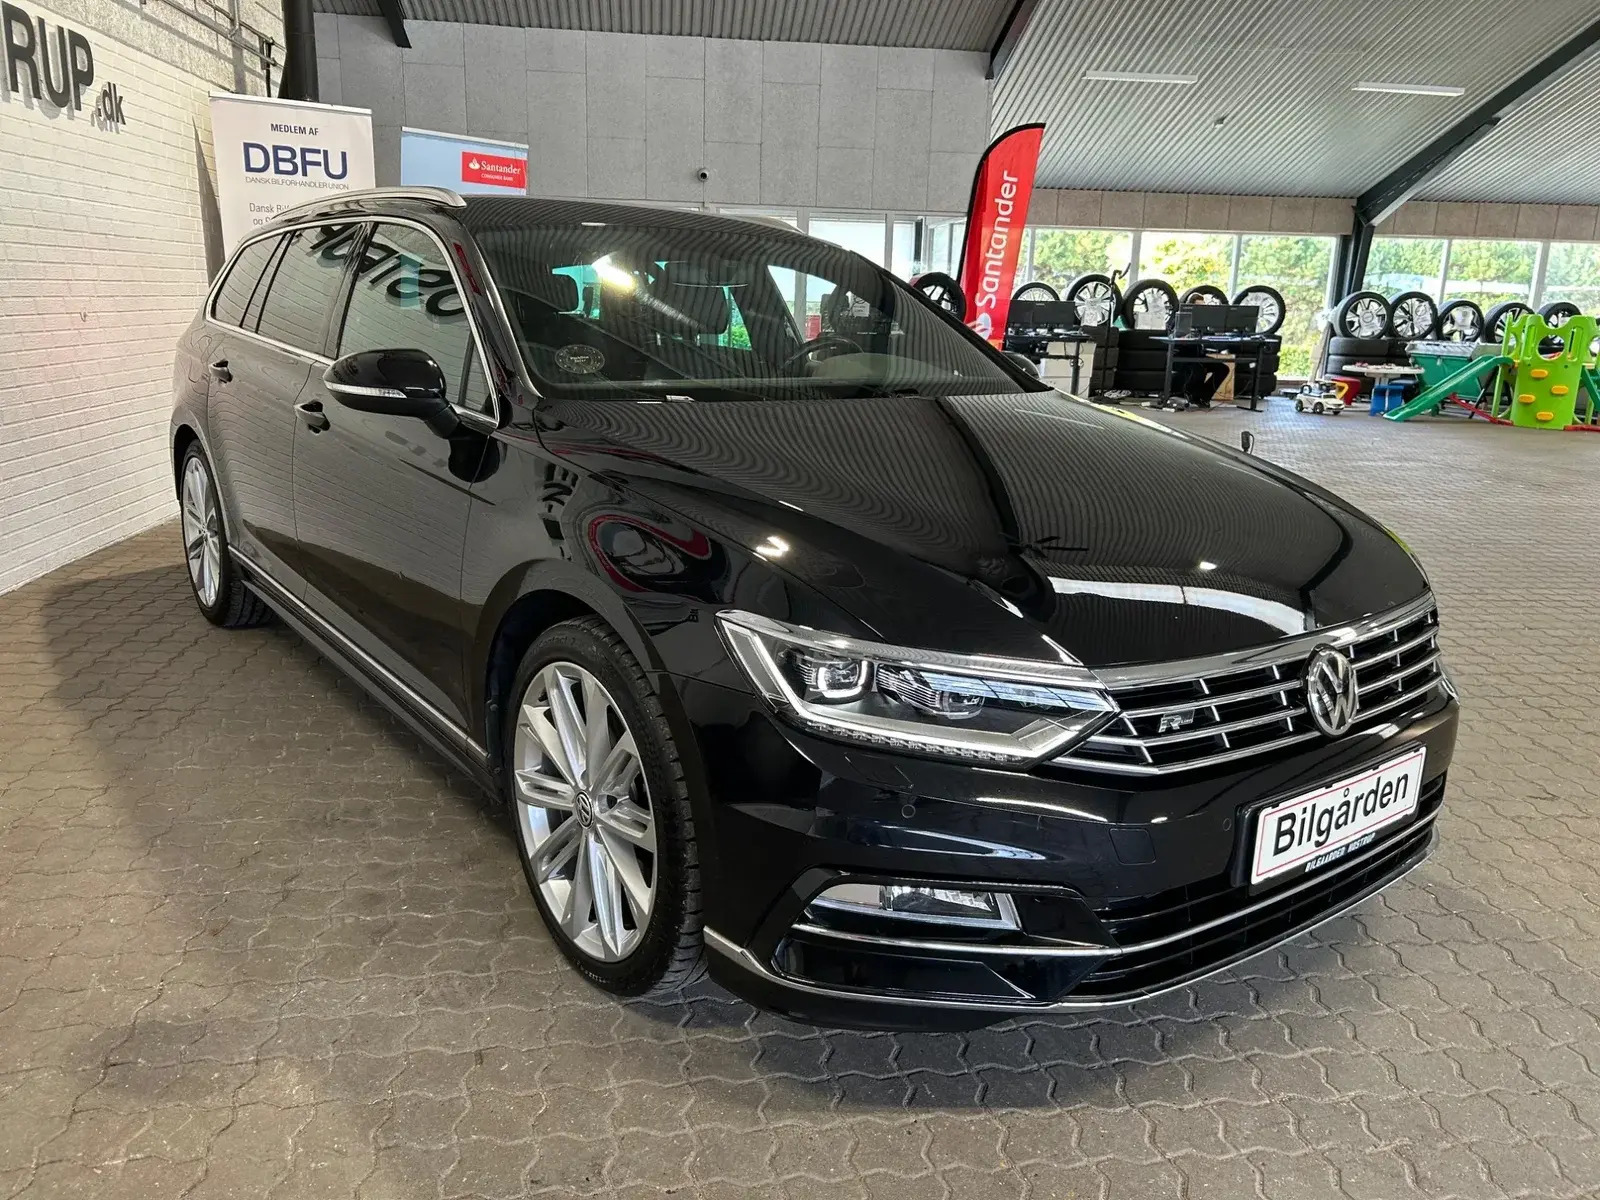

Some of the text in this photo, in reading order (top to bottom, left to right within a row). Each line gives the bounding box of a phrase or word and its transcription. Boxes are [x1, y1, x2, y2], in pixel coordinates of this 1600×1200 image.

[270, 123, 319, 136] MEDLEM AF
[243, 142, 348, 180] DBFU
[480, 160, 521, 175] Santander
[245, 176, 349, 190] DANSK BILFORHANDLER UNION
[249, 202, 275, 213] Dansk
[975, 170, 1018, 309] Santander
[1273, 773, 1409, 857] Bilgården
